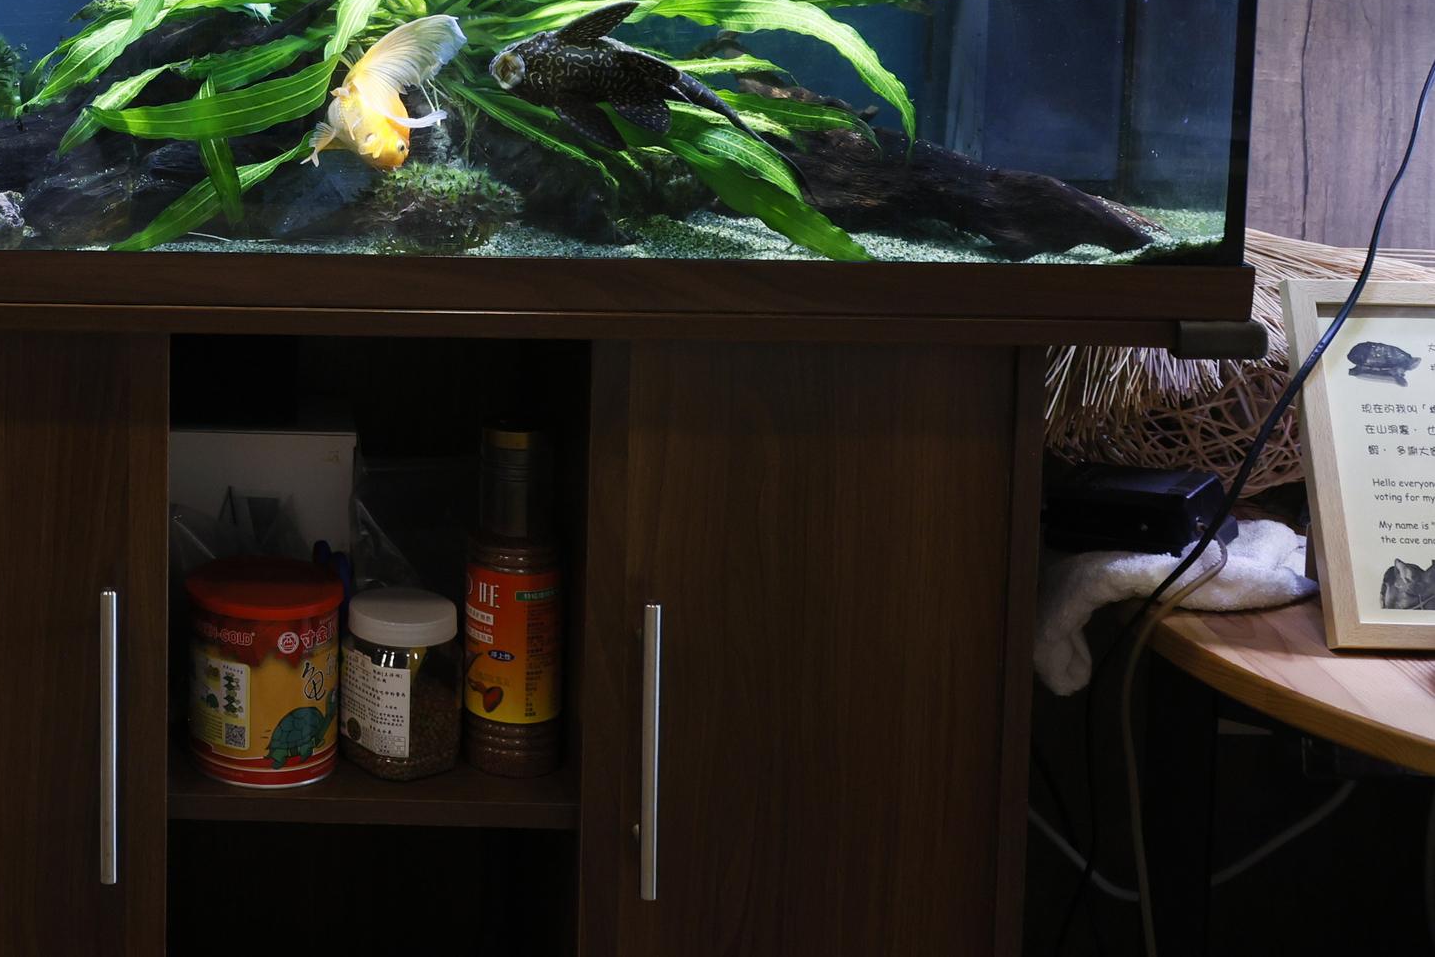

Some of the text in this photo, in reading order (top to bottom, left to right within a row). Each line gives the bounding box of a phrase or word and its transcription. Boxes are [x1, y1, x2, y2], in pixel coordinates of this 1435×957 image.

[1372, 478, 1435, 490] Hello everyon
[1375, 492, 1435, 504] voting for my
[1379, 520, 1429, 531] My name is
[1381, 535, 1396, 544] the
[1399, 537, 1420, 545] cave
